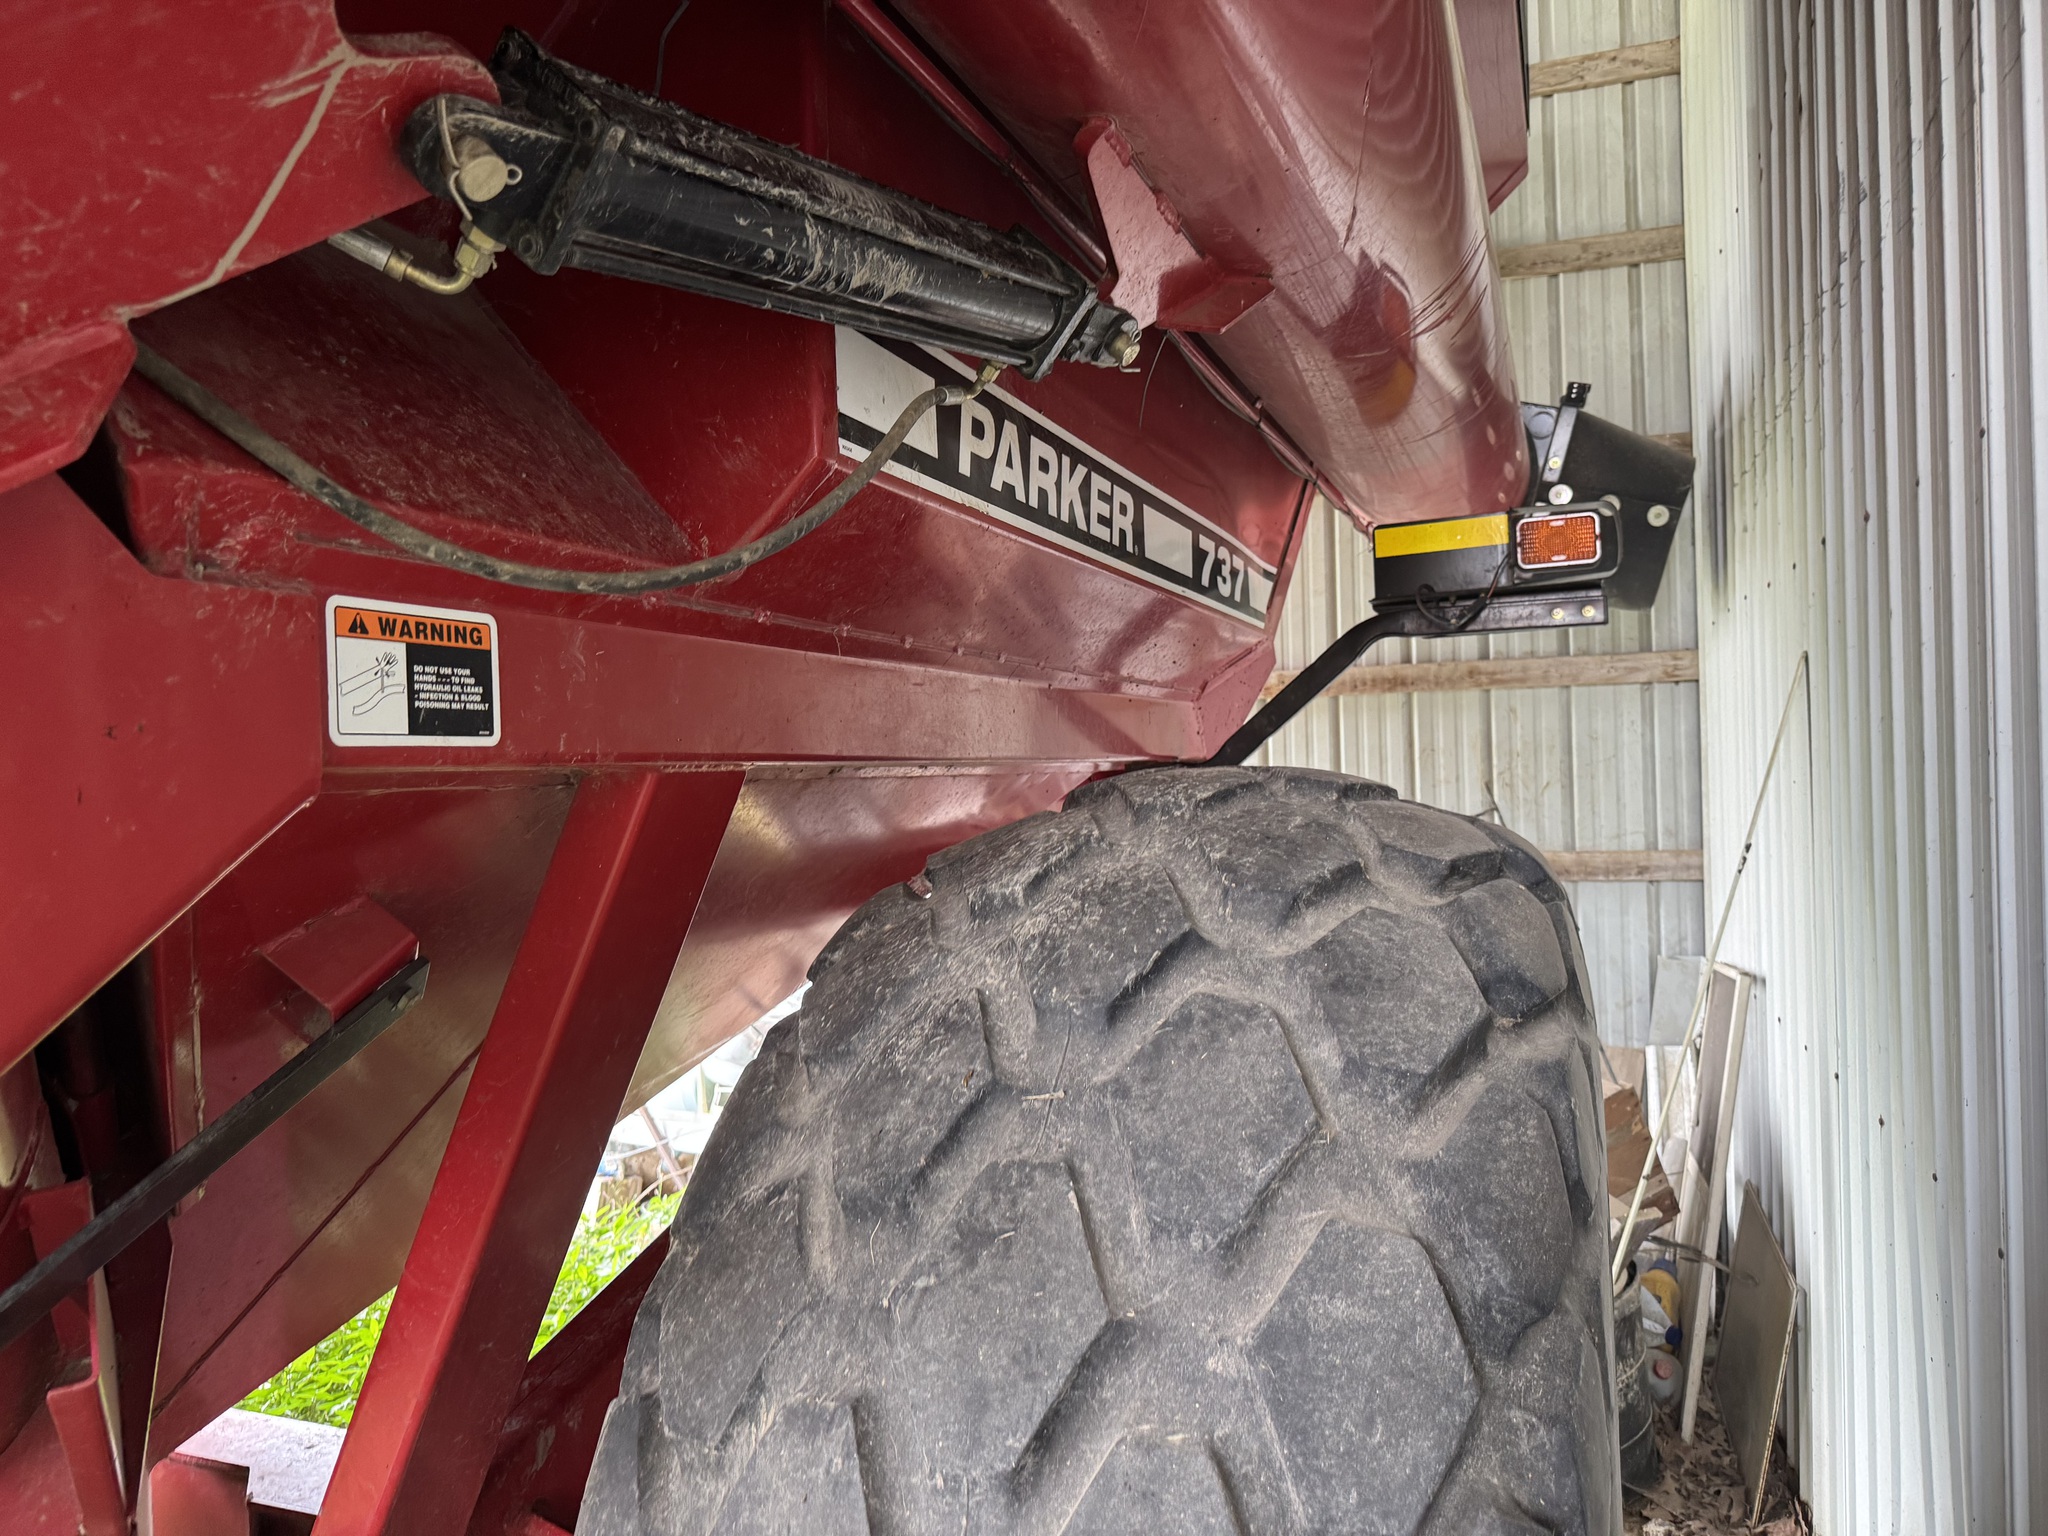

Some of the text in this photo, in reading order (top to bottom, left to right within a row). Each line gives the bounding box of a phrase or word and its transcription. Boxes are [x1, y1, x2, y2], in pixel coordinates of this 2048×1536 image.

[958, 400, 1244, 603] PARKER 737
[378, 616, 483, 646] WARNING
[414, 665, 423, 673] DO
[453, 668, 470, 676] YOUR
[414, 674, 436, 682] HANDS
[451, 676, 459, 684] TO
[461, 677, 475, 685] FIND
[414, 683, 451, 692] HYDRAULIC
[464, 686, 483, 694] LEAKS
[419, 692, 453, 700] INFECTION
[461, 694, 481, 702] BLOOD
[415, 701, 450, 709] POISONING
